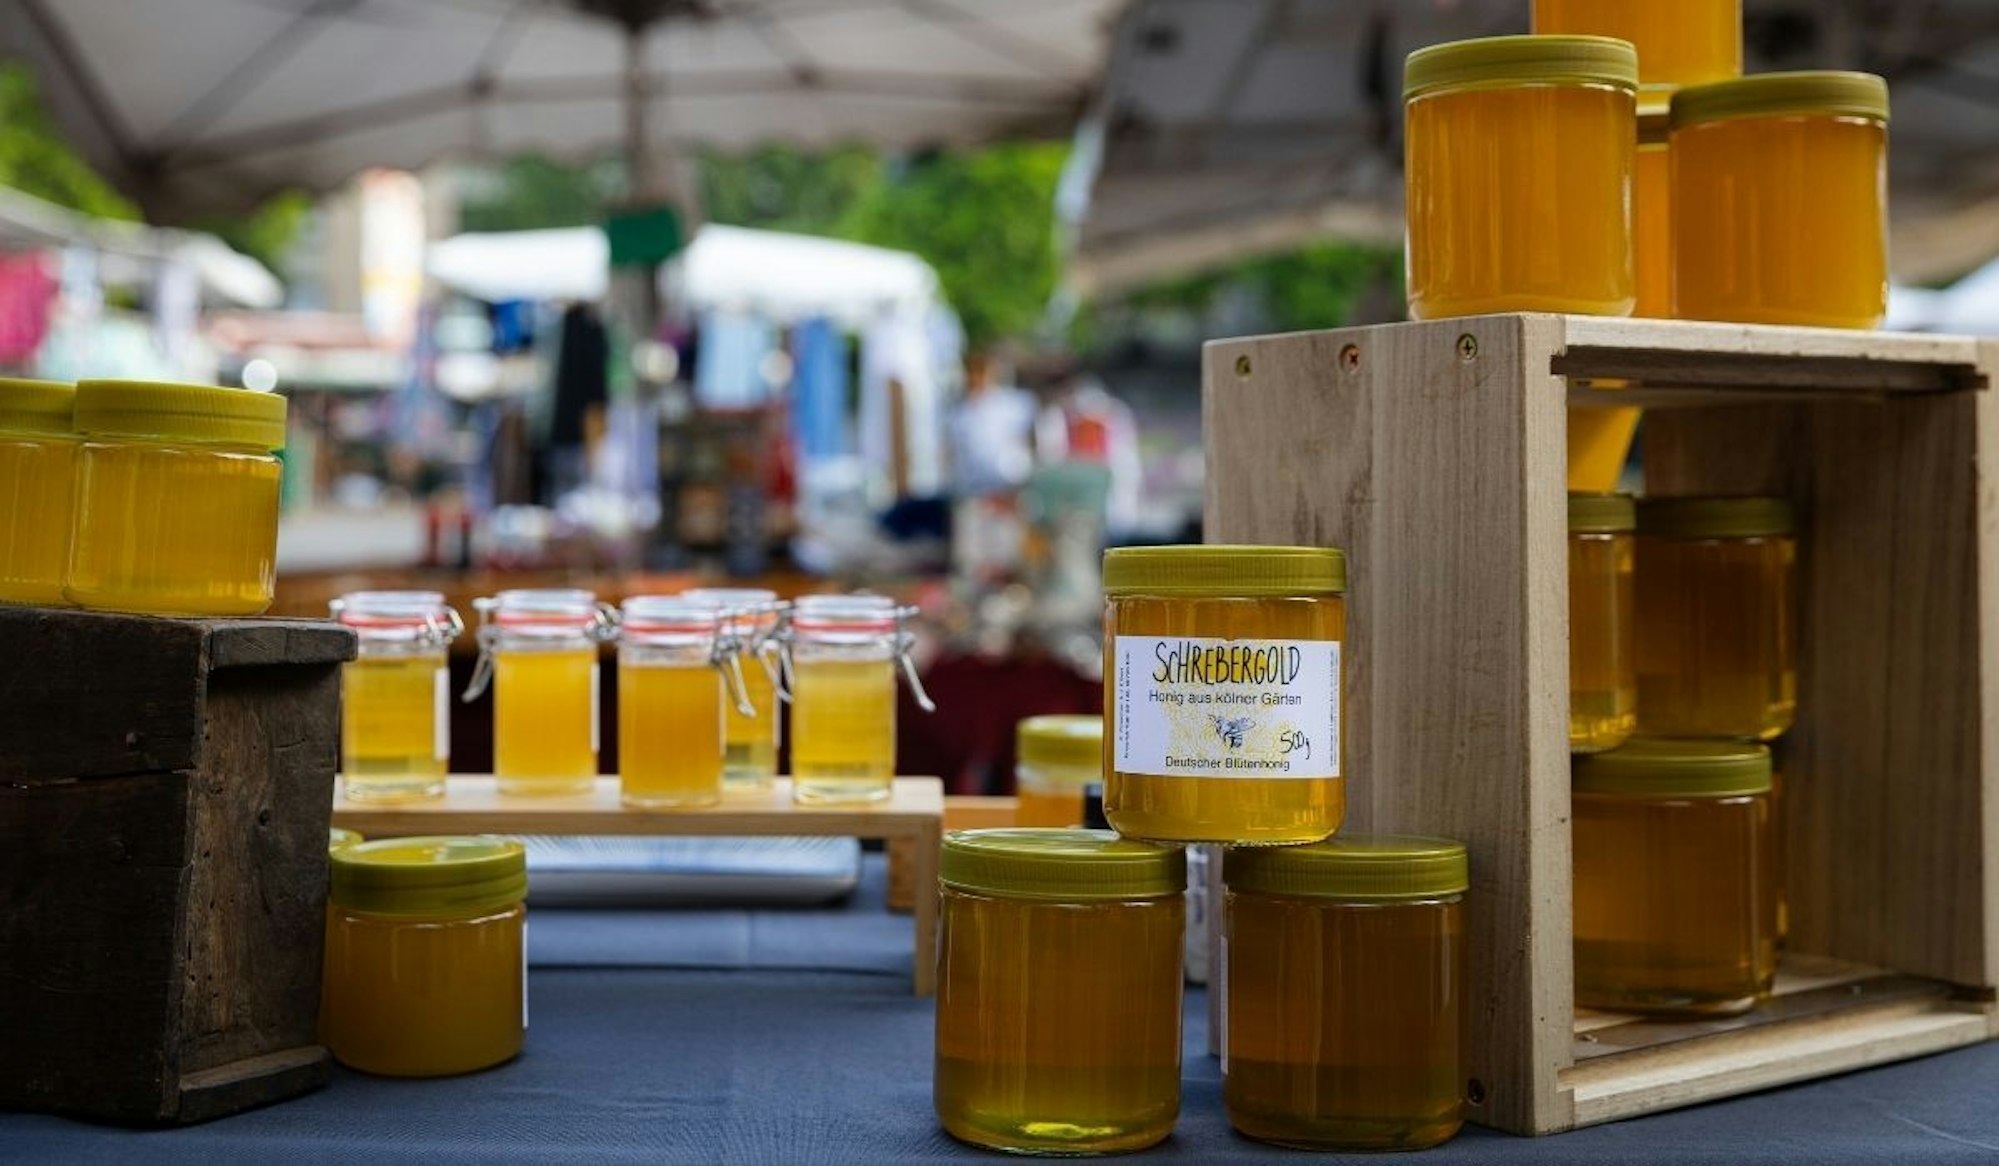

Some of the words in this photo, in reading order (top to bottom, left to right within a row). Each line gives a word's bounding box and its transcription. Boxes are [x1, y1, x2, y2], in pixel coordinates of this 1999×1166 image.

[1149, 689, 1184, 706] Honig
[1187, 694, 1212, 704] aus
[1215, 691, 1257, 705] kölner
[1261, 692, 1302, 706] Gärten
[1280, 730, 1310, 760] 500g
[1165, 755, 1221, 769] Deutscher
[1225, 757, 1290, 772] Blütenhonig
